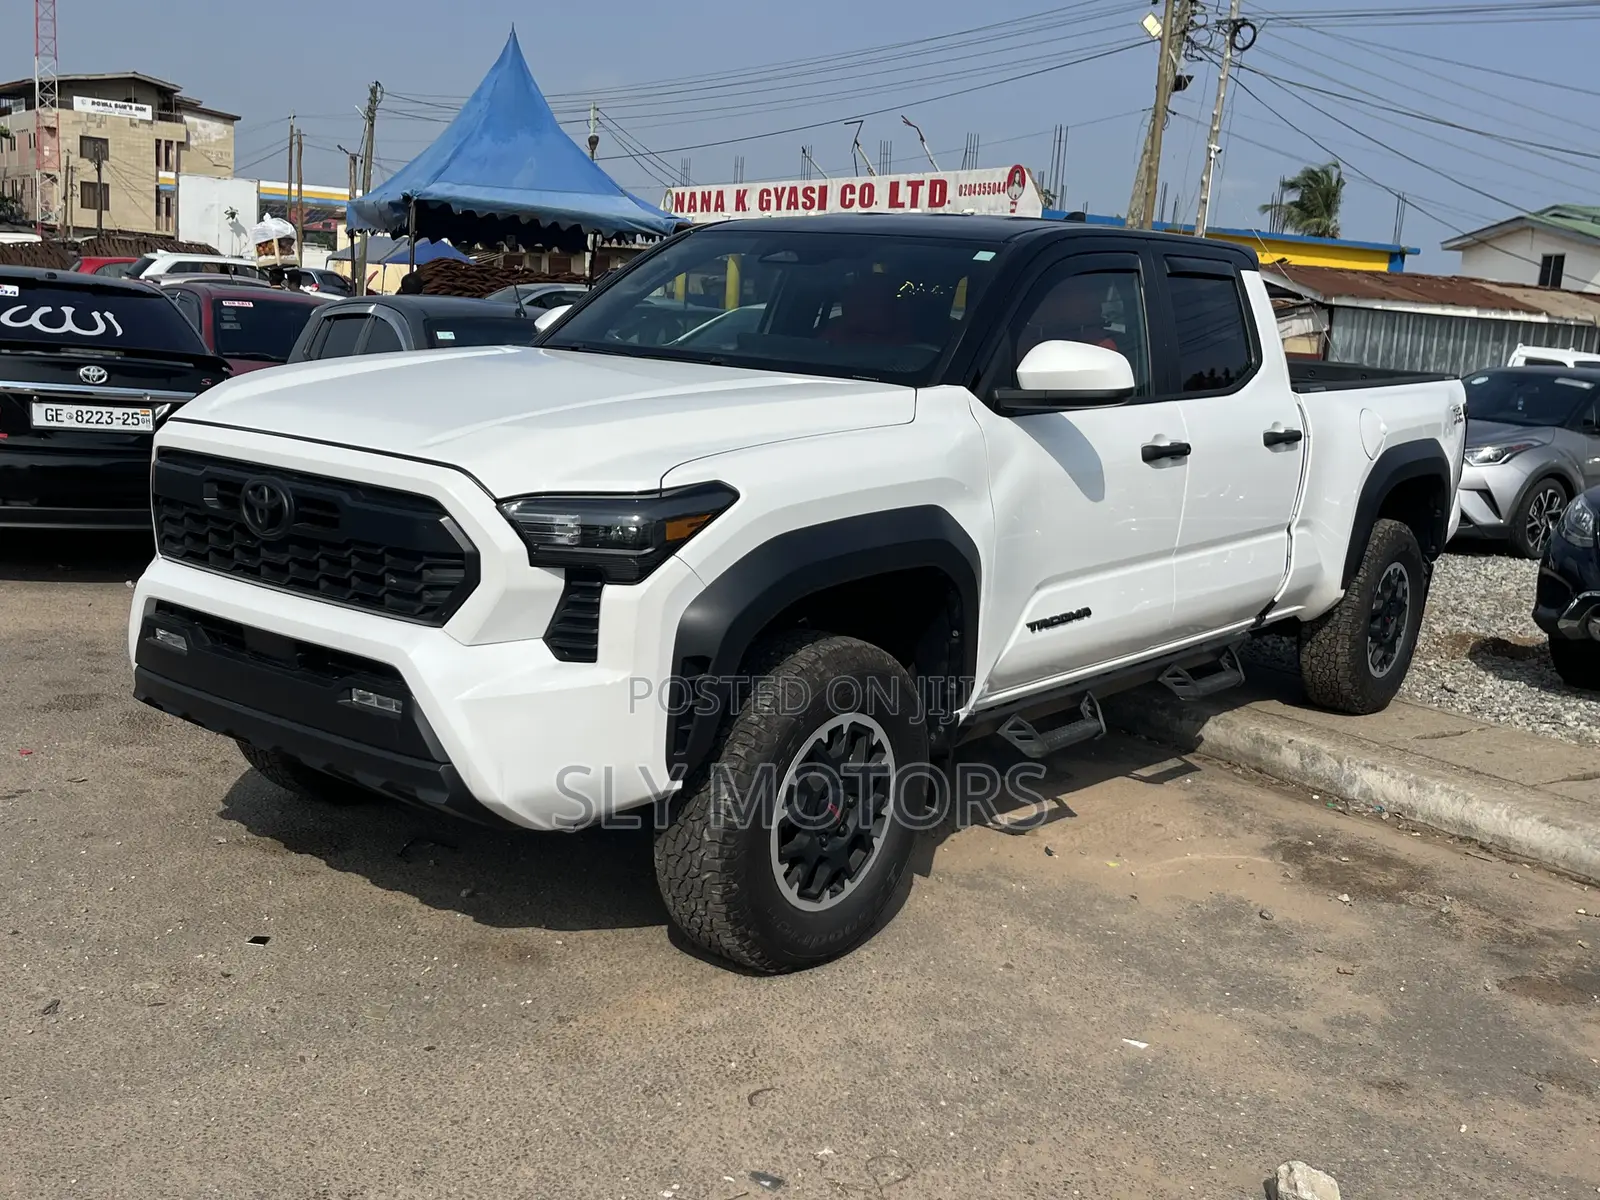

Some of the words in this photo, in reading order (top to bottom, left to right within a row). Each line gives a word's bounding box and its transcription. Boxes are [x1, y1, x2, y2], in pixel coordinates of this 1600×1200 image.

[674, 189, 725, 213] NANA
[734, 189, 750, 212] K.
[758, 185, 828, 212] GYASI
[839, 182, 878, 209] CO.
[887, 179, 951, 209] LTD.
[958, 181, 1007, 197] 0204355044
[44, 408, 65, 423] GE
[75, 410, 141, 426] 8223-25
